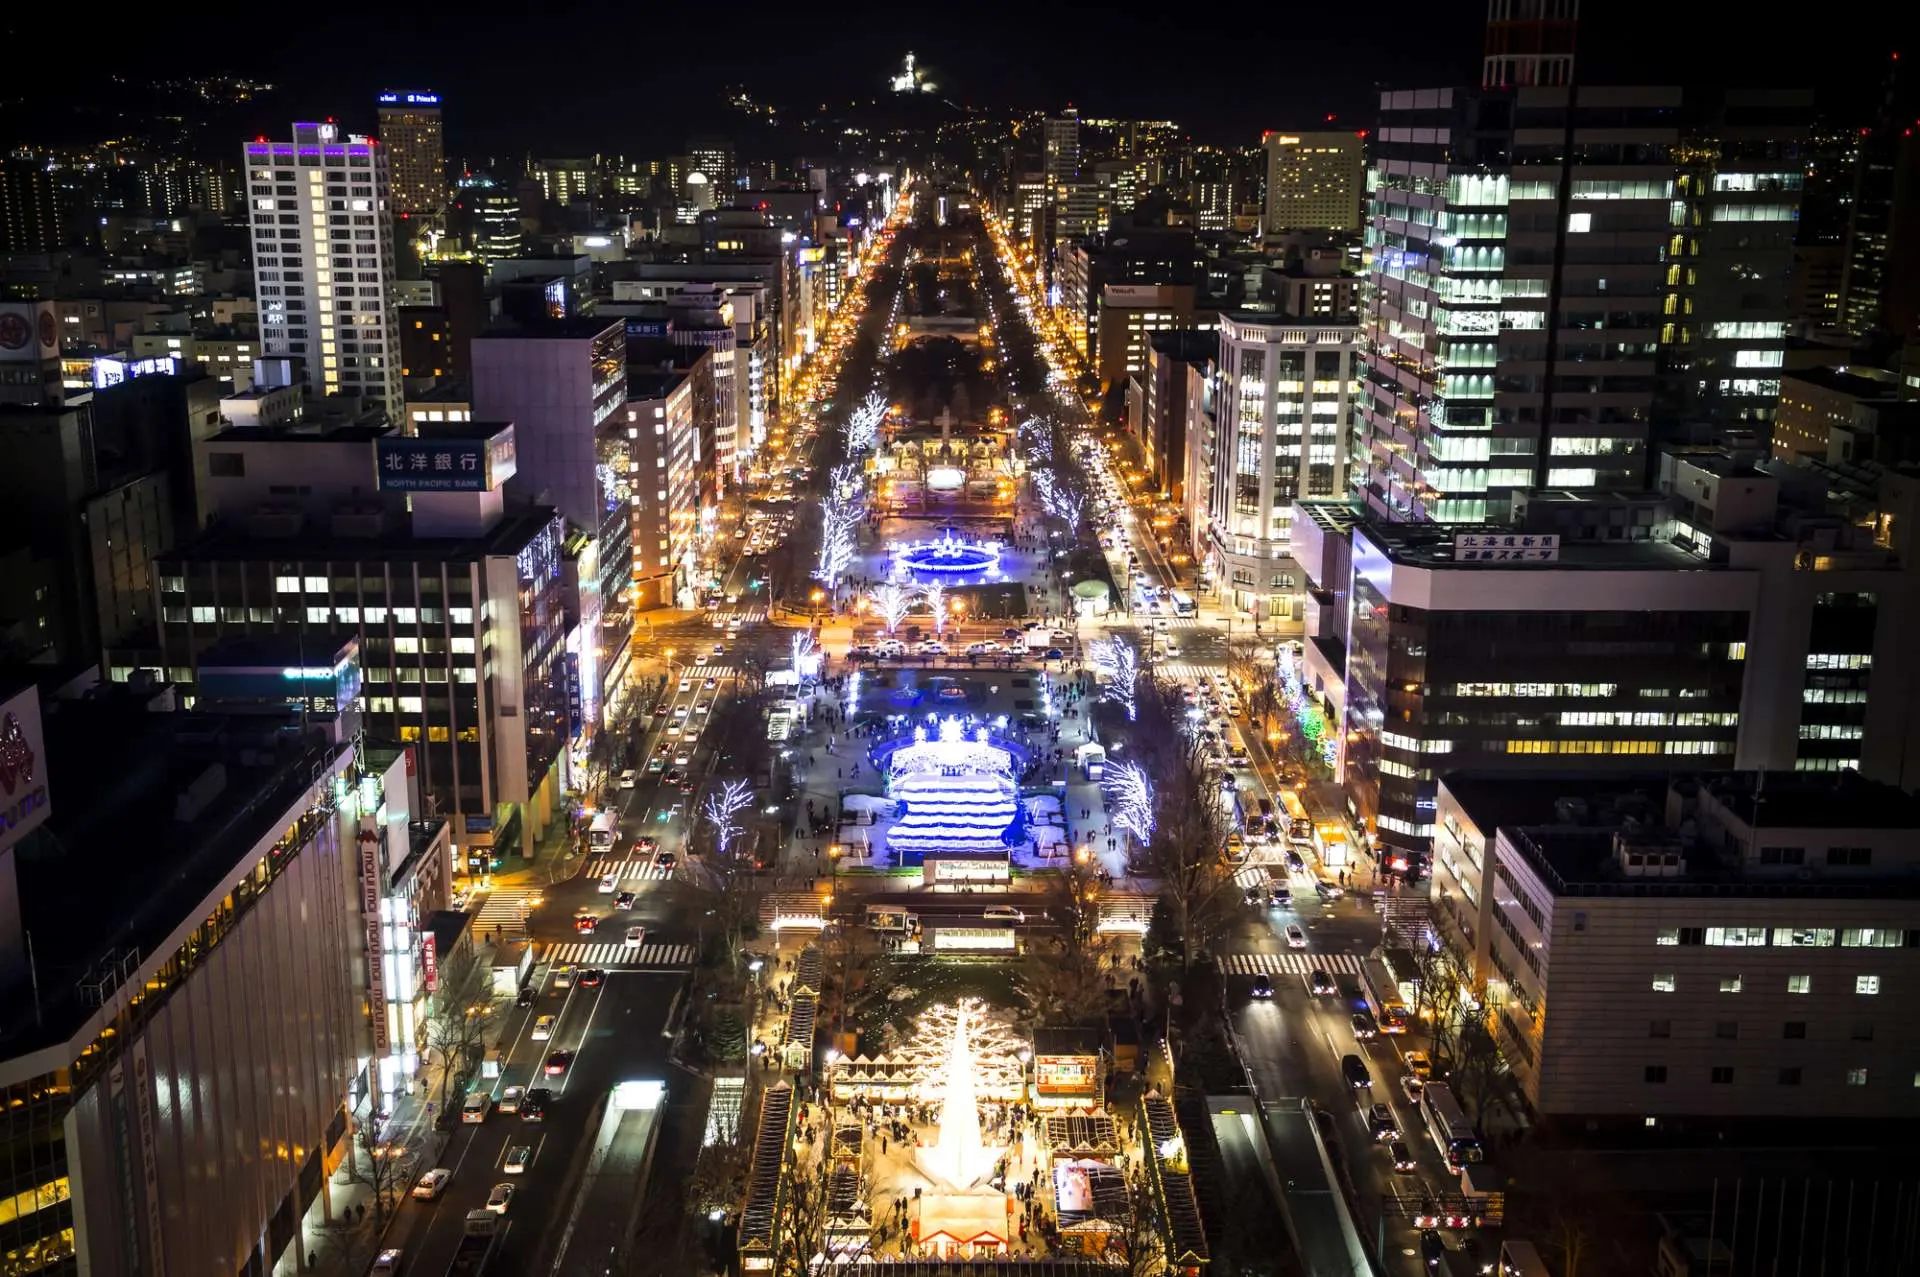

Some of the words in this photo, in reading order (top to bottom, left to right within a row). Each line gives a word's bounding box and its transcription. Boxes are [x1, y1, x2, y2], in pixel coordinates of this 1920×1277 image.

[385, 453, 478, 471] 北洋銀行
[386, 479, 416, 489] NORTH
[418, 479, 452, 489] PACIFIC
[455, 479, 479, 489] BANK
[1463, 536, 1553, 547] 北海道新聞
